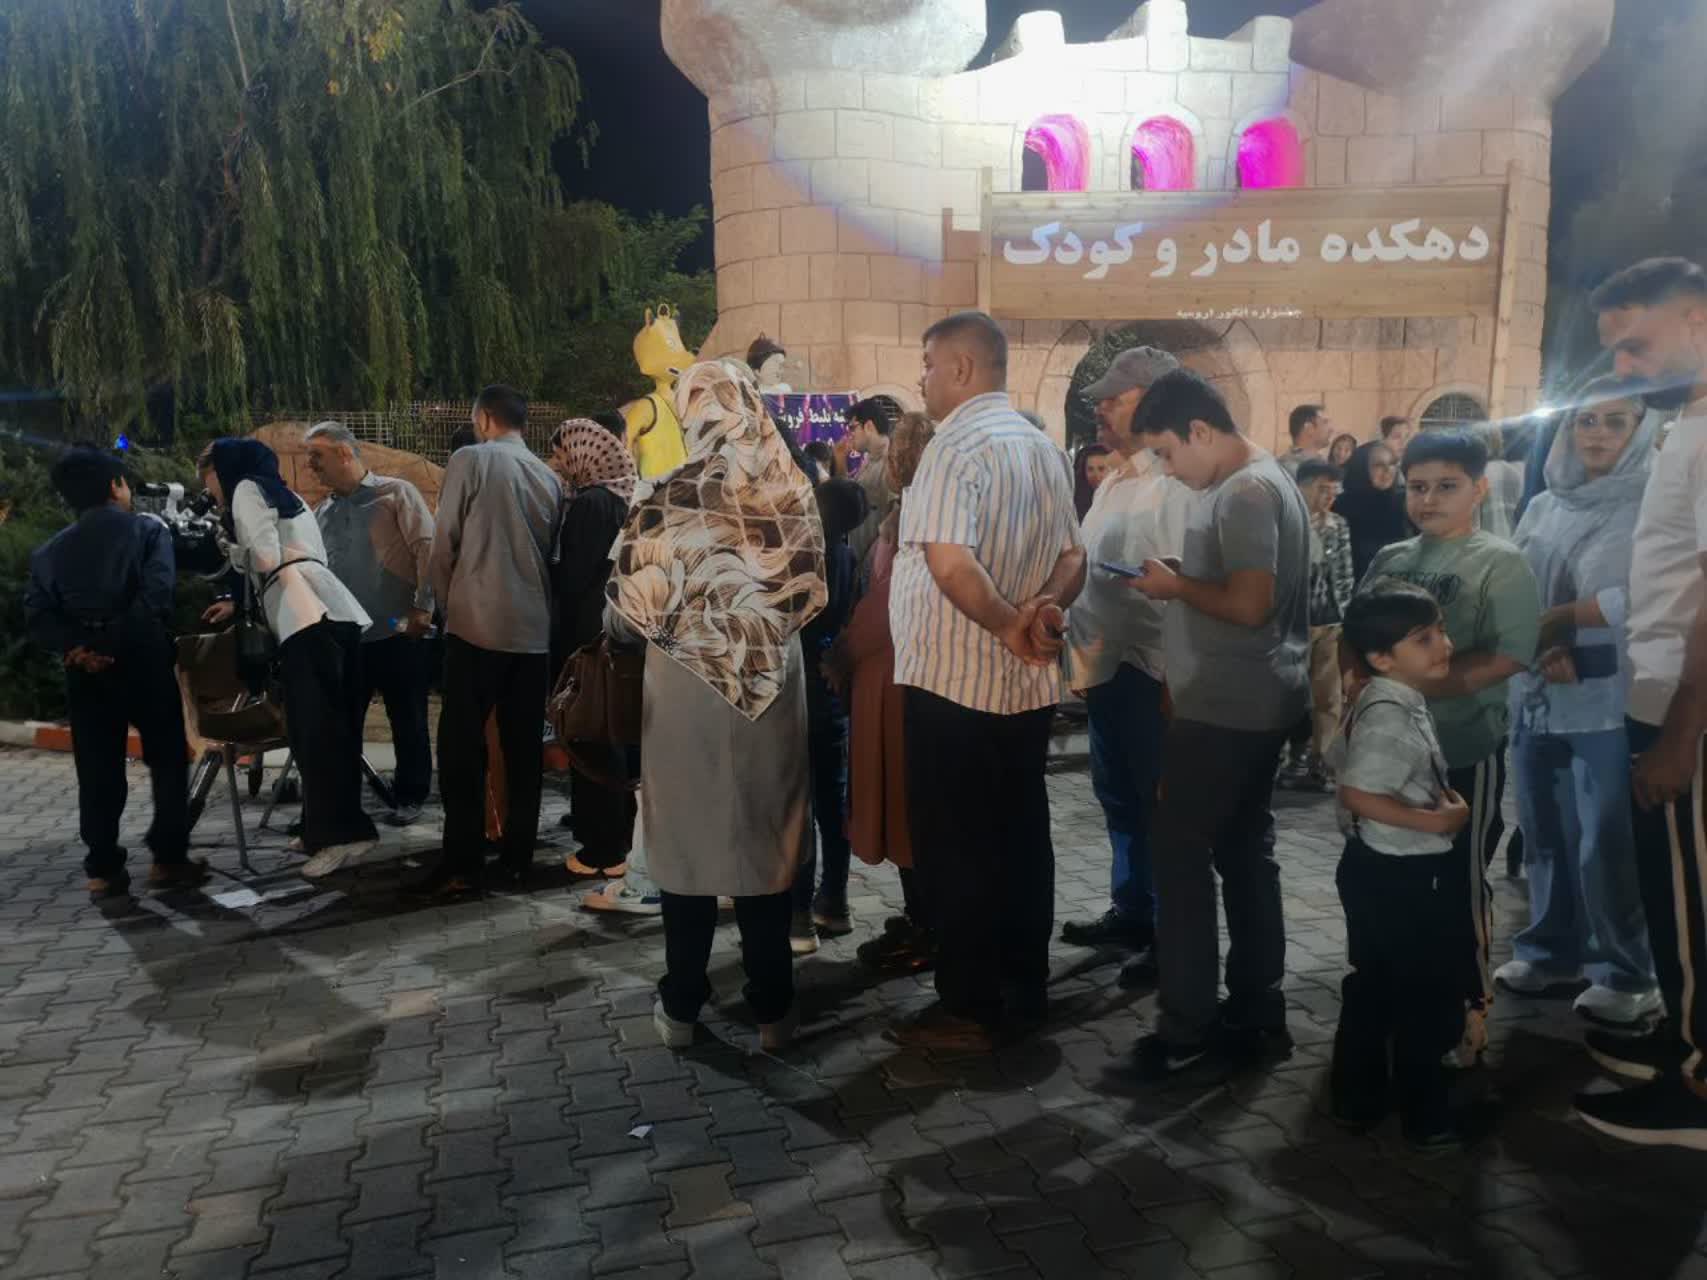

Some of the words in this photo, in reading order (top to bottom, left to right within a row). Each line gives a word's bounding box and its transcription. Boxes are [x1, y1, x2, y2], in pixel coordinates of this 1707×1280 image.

[1003, 221, 1143, 280] کودک
[1150, 238, 1177, 278] و
[1190, 218, 1300, 278] مادر
[1320, 218, 1489, 263] دهکده
